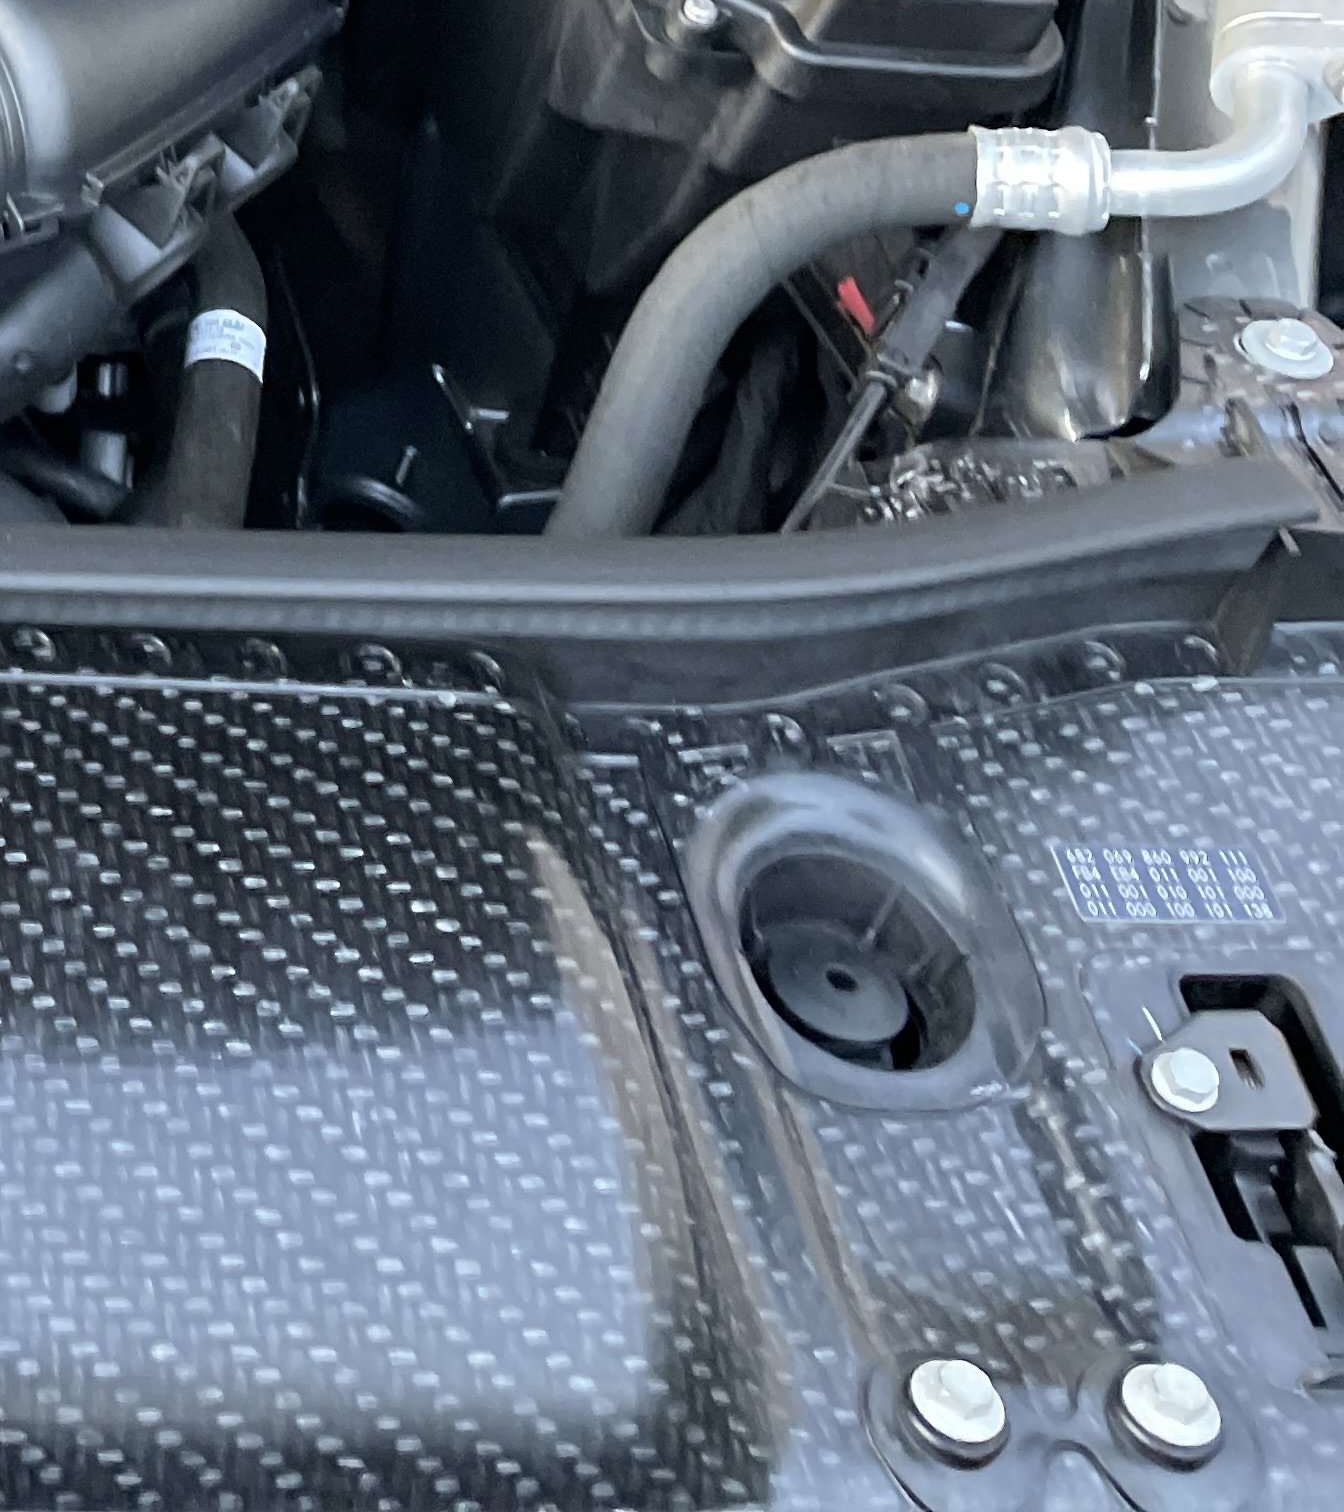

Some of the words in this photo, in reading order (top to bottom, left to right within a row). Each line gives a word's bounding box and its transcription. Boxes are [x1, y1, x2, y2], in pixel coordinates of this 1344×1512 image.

[1179, 849, 1210, 866] 992
[1218, 849, 1248, 865] 111
[1149, 866, 1179, 882] 011
[1187, 867, 1218, 883] 001
[1226, 867, 1257, 884] 100
[1079, 883, 1110, 899] 011
[1117, 884, 1148, 900] 001
[1156, 884, 1188, 900] 010
[1197, 885, 1226, 901] 101
[1233, 885, 1265, 901] 000
[1087, 901, 1117, 916] 011
[1125, 901, 1157, 917] 000
[1166, 902, 1196, 918] 100
[1204, 903, 1233, 918] 101
